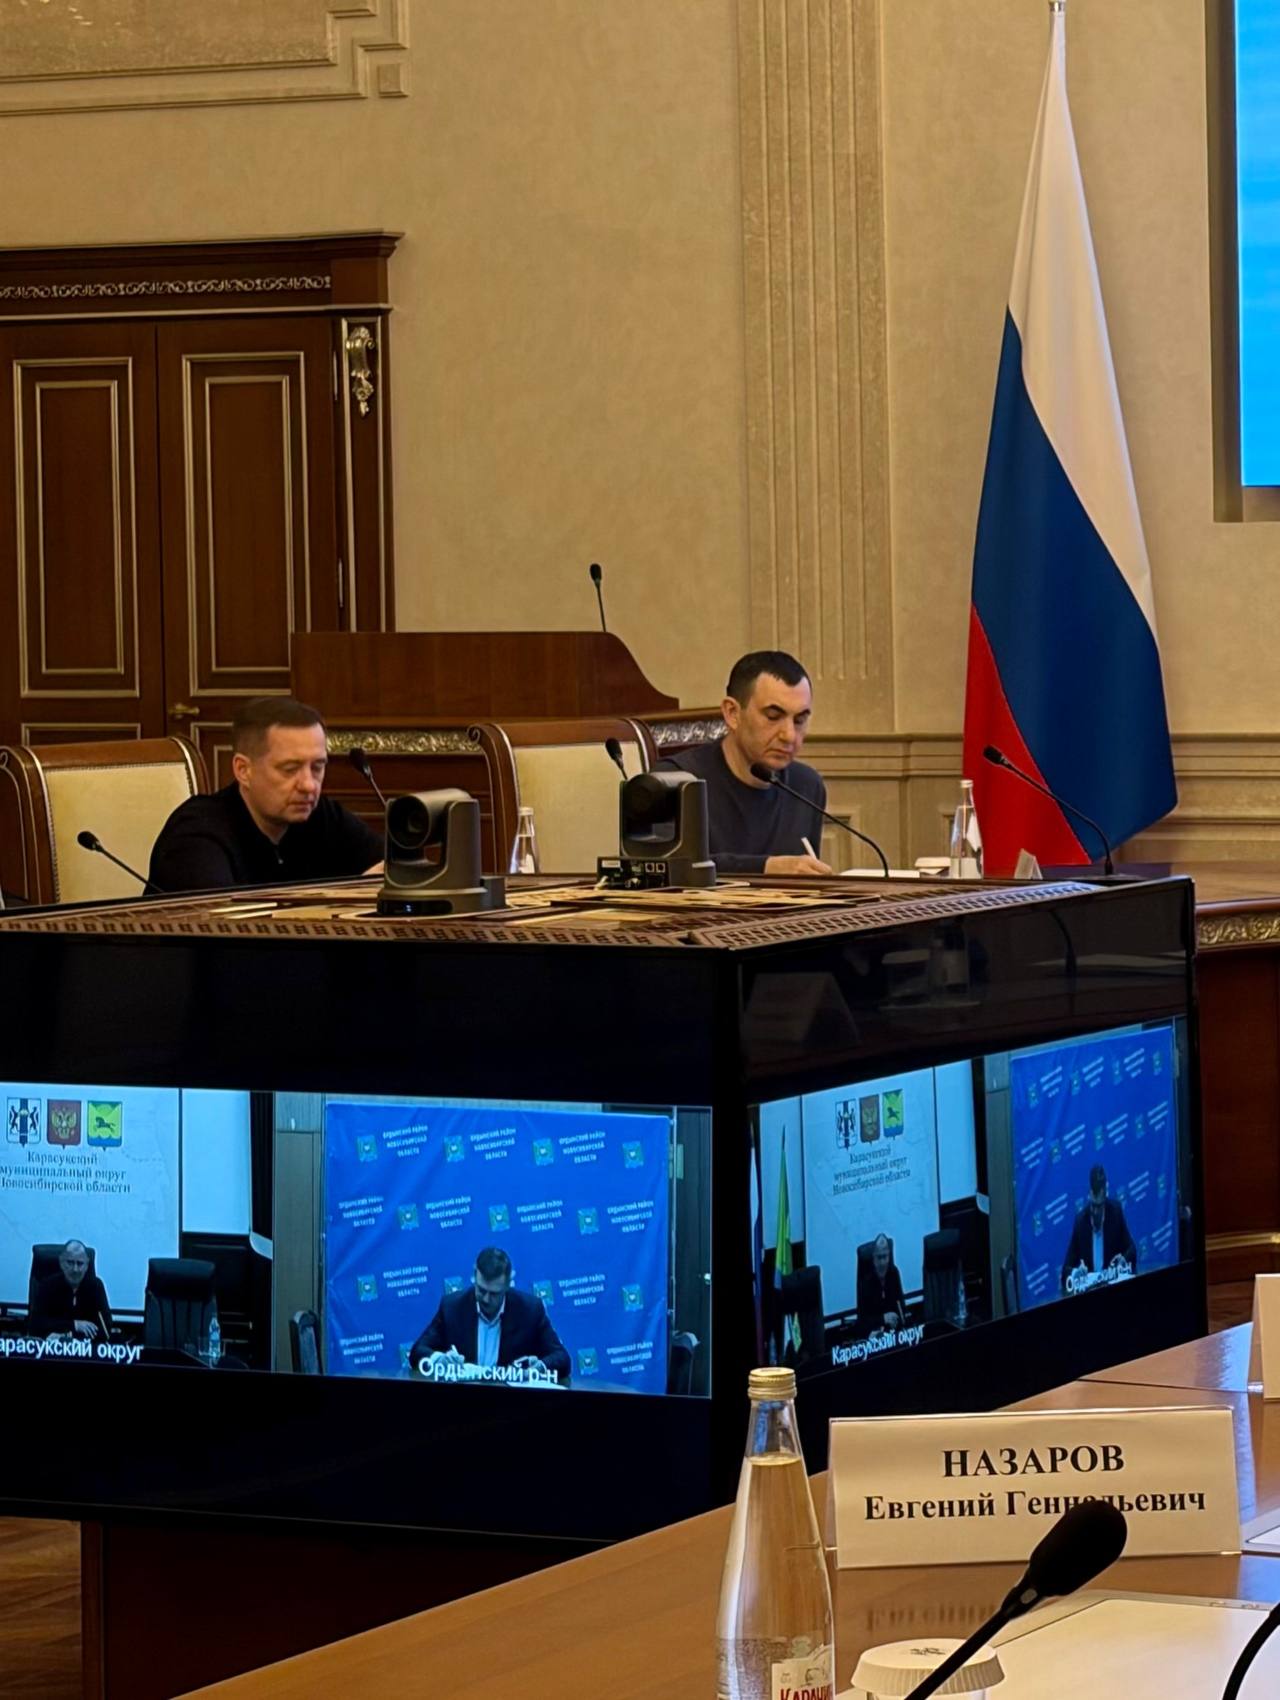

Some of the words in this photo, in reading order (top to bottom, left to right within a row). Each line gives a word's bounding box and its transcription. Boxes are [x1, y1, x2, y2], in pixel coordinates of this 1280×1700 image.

[898, 1324, 926, 1347] округ
[97, 1342, 144, 1364] округ
[529, 1366, 558, 1383] р-н
[943, 1444, 1124, 1477] НАЗАРОВ
[864, 1493, 995, 1520] Евгений
